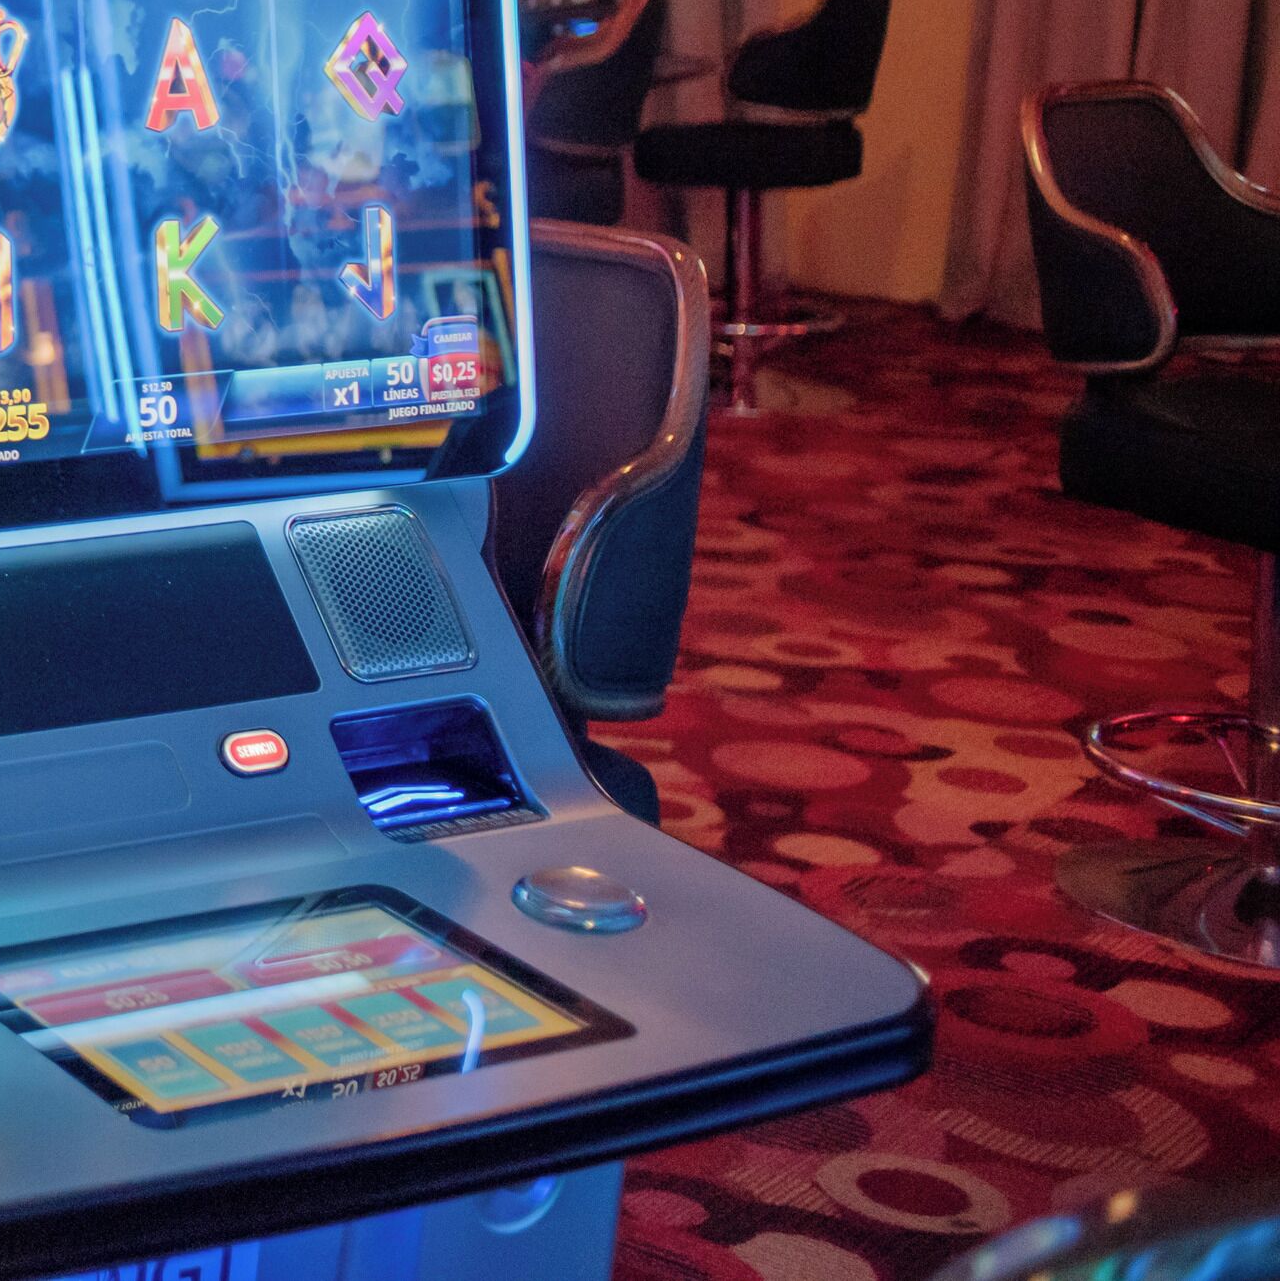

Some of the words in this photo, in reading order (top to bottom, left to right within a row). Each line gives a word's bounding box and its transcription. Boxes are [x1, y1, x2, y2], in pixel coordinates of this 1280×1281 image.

[145, 17, 221, 132] A
[155, 215, 226, 332] K
[339, 205, 396, 321] J
[325, 367, 370, 380] APUESTA
[386, 361, 414, 386] 50
[432, 360, 477, 385] $0,25
[333, 381, 360, 407] x1
[383, 387, 420, 402] LÍNEAS
[140, 395, 178, 427] 50
[388, 404, 418, 420] JUEGO
[420, 400, 476, 416] FINALIZADO
[165, 427, 193, 439] TOTAL
[236, 740, 278, 759] SERVICIO
